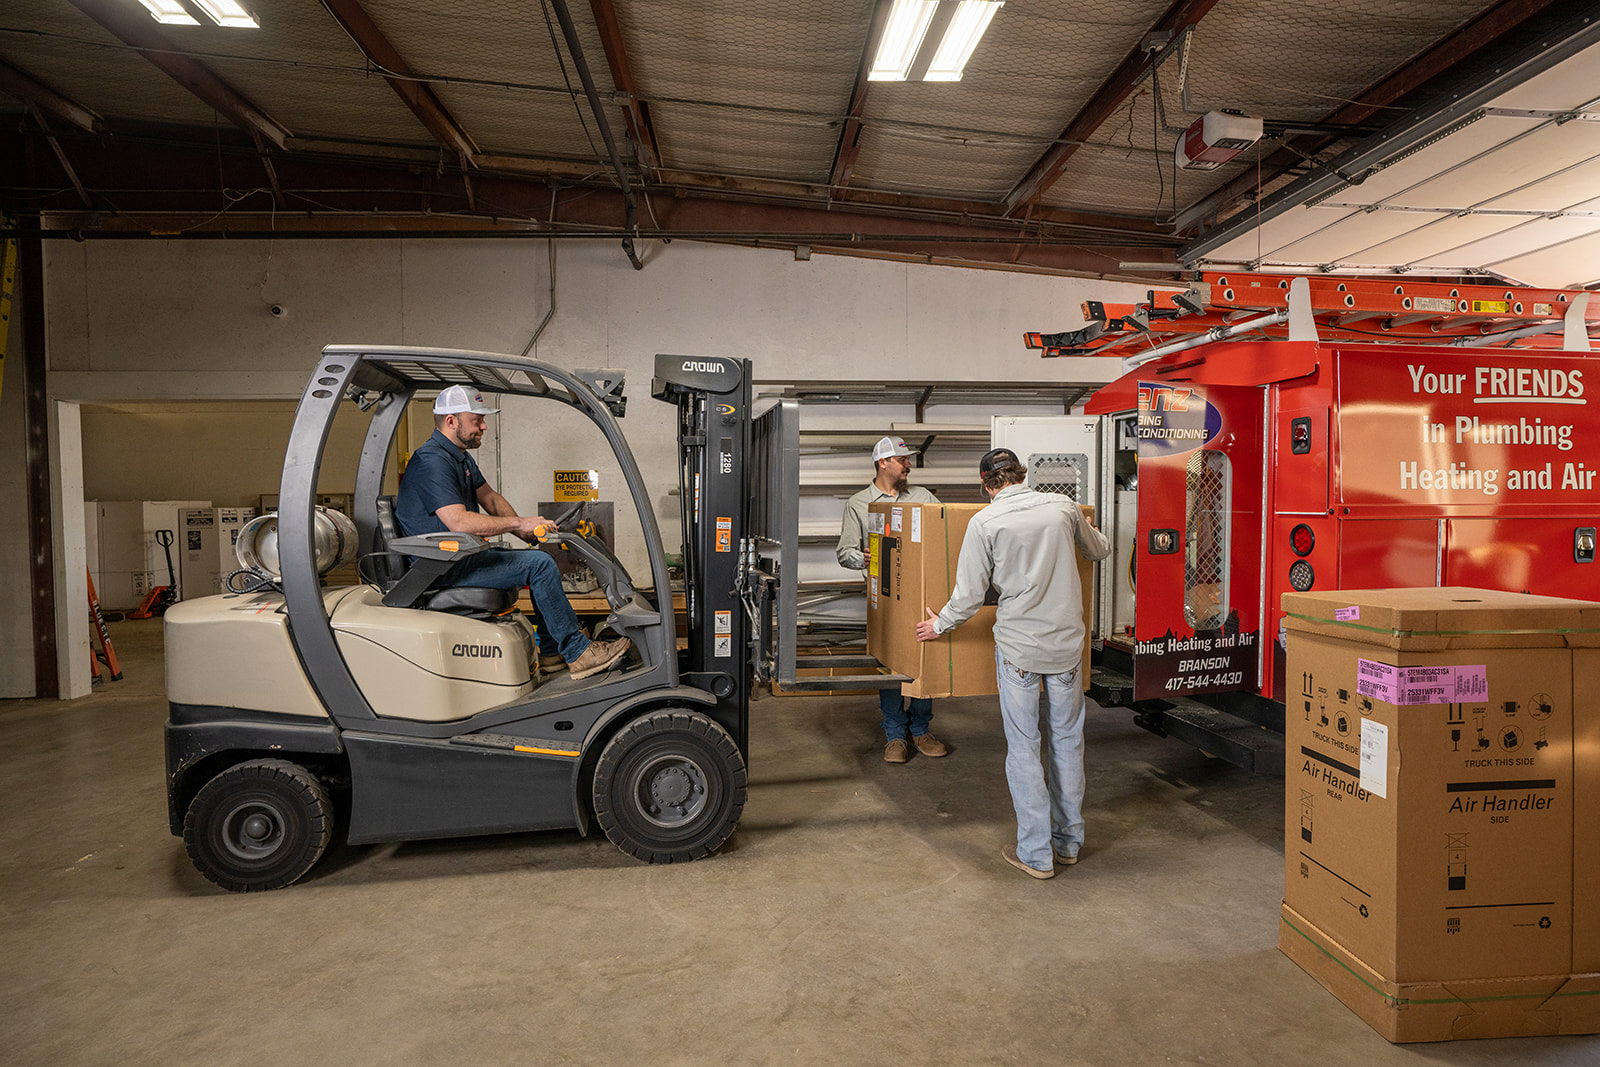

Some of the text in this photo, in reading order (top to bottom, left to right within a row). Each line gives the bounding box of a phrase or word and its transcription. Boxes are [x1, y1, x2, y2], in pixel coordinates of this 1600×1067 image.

[682, 361, 725, 373] CROWN
[1407, 364, 1584, 398] Your FRIENDS
[1423, 415, 1573, 451] in Plumbing
[723, 452, 732, 474] 1280
[556, 473, 591, 482] CAUTIO
[1400, 461, 1597, 496] Heating and Air
[452, 644, 503, 658] CROWN
[1167, 636, 1213, 652] Heating
[1215, 634, 1235, 648] and
[1238, 632, 1255, 646] Air
[1178, 656, 1231, 673] BRANSON
[1164, 671, 1243, 691] 417-544-4430
[1312, 730, 1359, 756] TRUCK THIS SIDE
[1464, 757, 1535, 768] TRUCK THIS SIDE
[1302, 760, 1372, 803] Air Handler
[1448, 793, 1554, 814] Air Handler
[1490, 815, 1510, 824] SIDE
